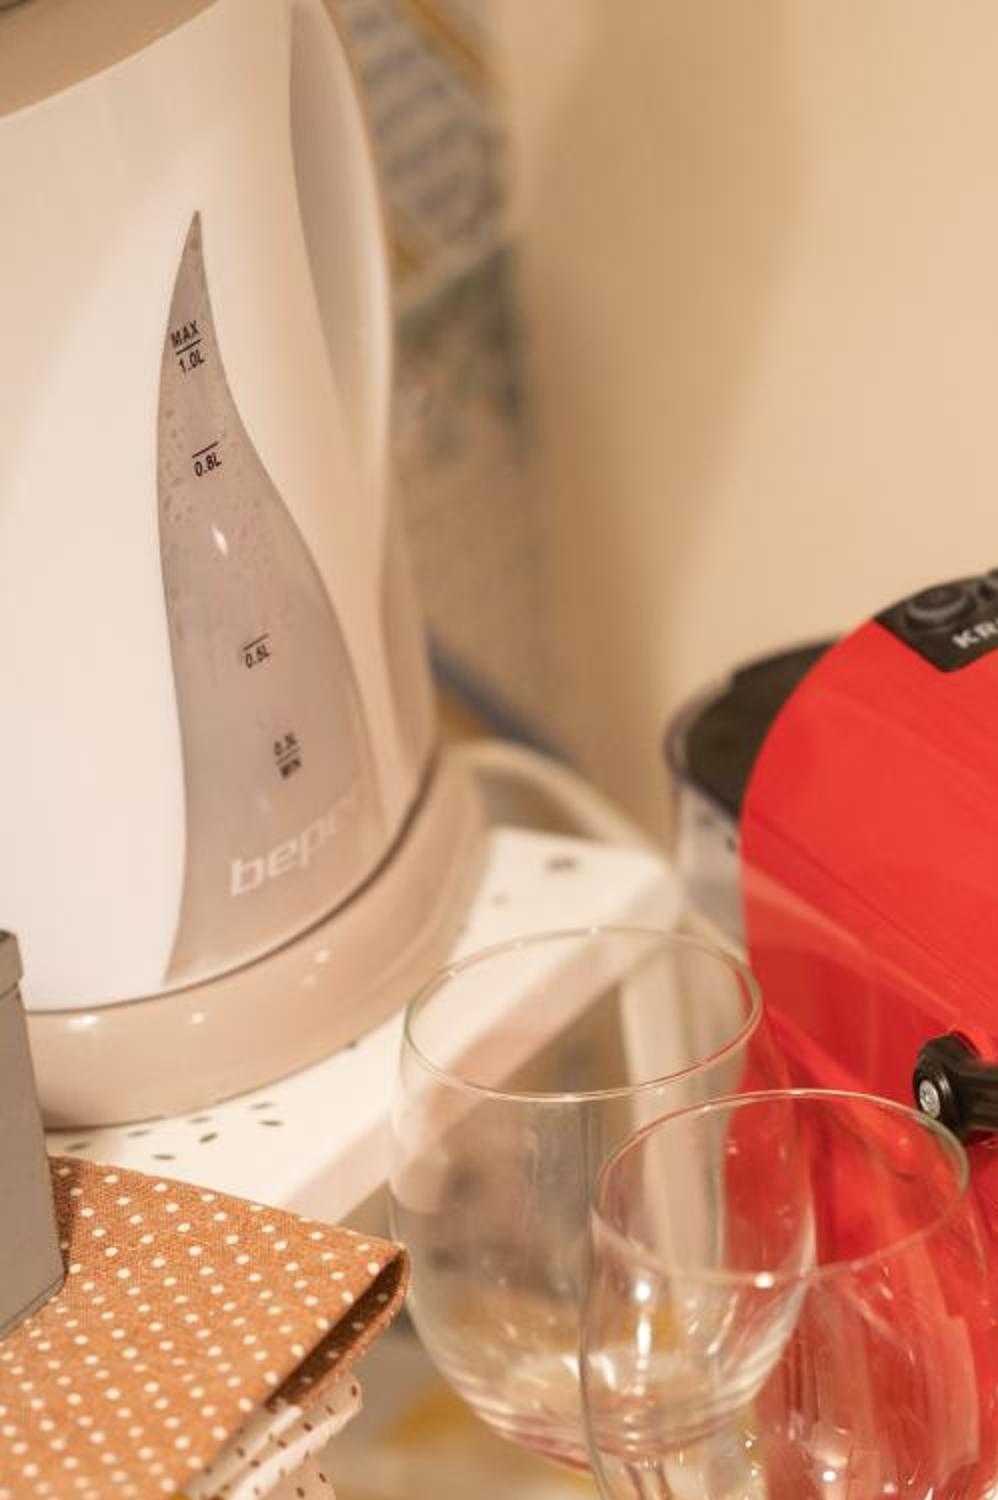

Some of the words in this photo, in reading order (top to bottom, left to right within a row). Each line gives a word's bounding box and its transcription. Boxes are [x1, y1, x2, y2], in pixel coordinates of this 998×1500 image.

[171, 320, 199, 347] MAX
[179, 349, 206, 374] 1.0L
[193, 452, 222, 477] 0.8L
[244, 643, 270, 669] 0.5L
